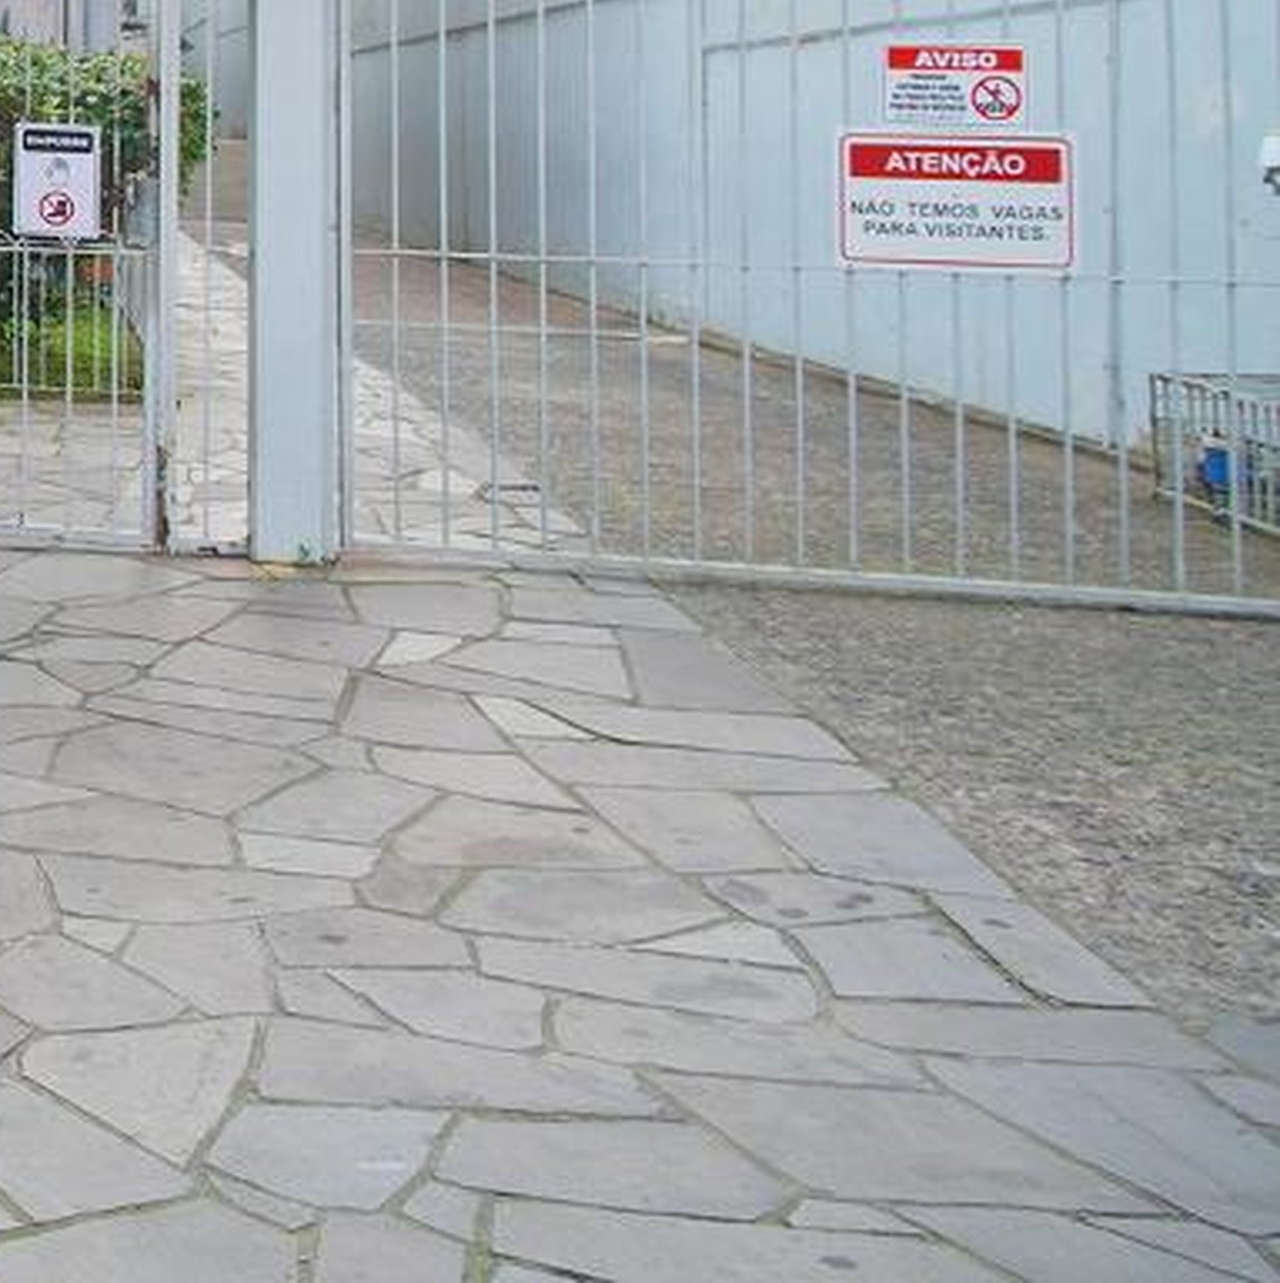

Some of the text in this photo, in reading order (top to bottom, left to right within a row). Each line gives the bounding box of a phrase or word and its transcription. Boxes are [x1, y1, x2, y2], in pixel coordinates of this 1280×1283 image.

[915, 51, 997, 68] AVISO
[885, 150, 1026, 177] ATENÇÃO
[908, 203, 980, 219] TEMOS
[991, 205, 1064, 221] VAGAS
[864, 220, 917, 237] PARA
